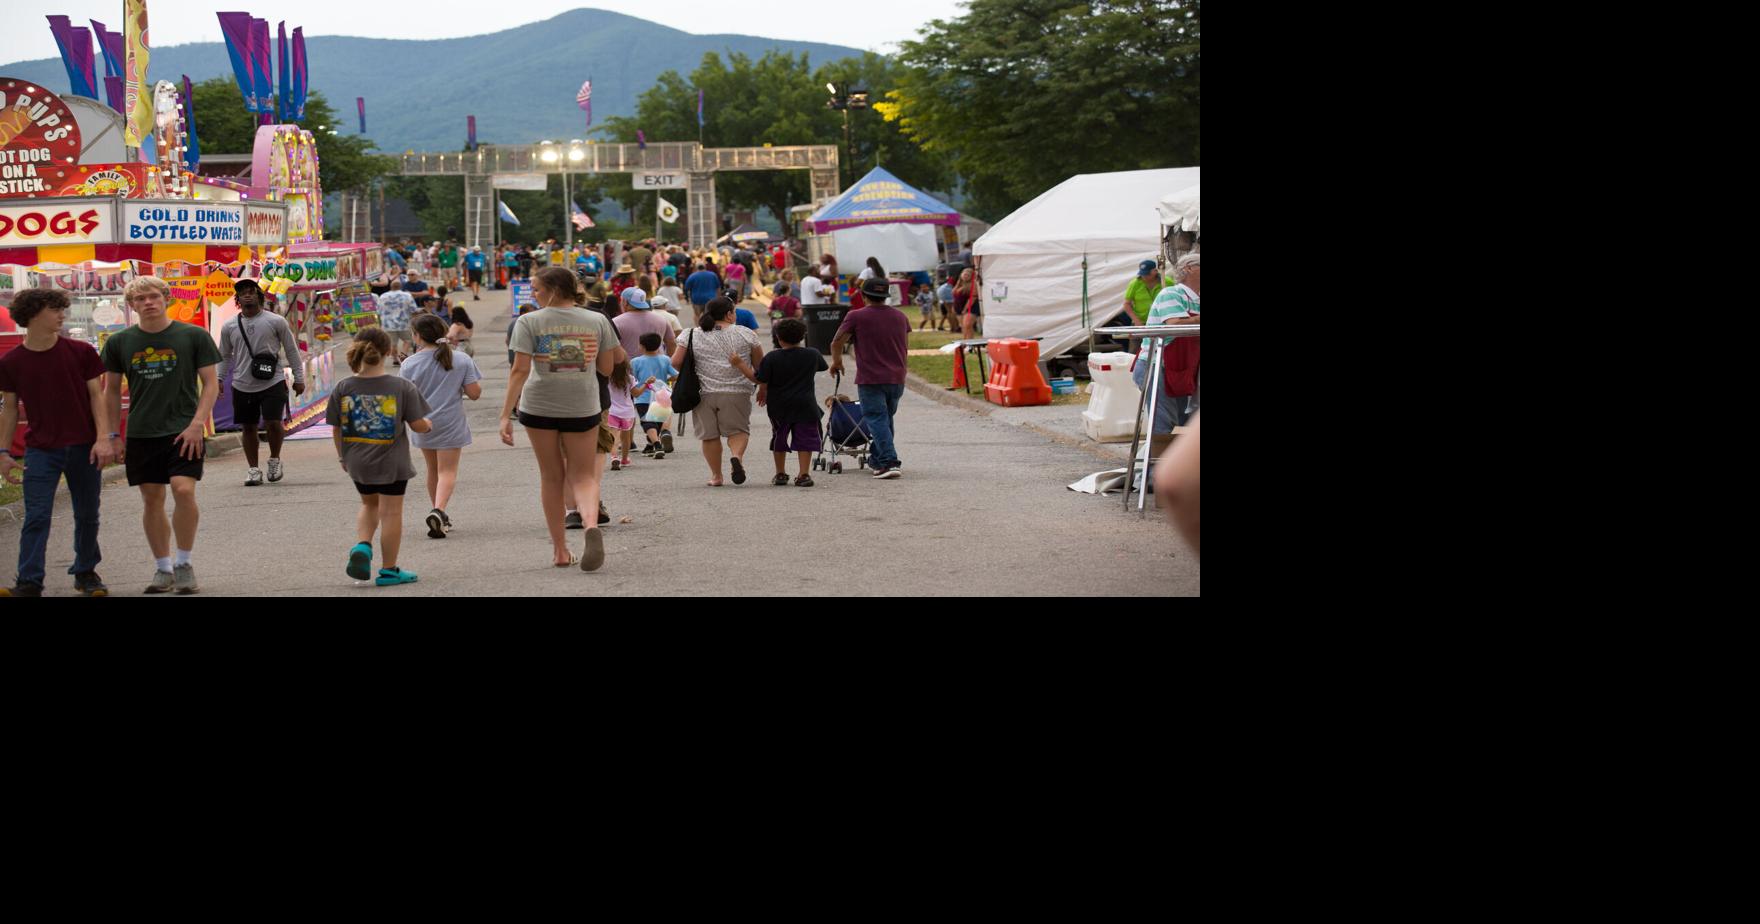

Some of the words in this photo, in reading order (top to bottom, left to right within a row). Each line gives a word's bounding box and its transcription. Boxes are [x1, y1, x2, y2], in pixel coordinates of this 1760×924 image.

[13, 94, 68, 142] PUPS
[0, 150, 16, 163] OT
[19, 148, 51, 162] DOG
[2, 165, 24, 179] ON
[26, 164, 37, 177] A
[88, 172, 121, 185] FAMILY
[0, 178, 45, 194] STICK
[644, 175, 673, 185] EXIT
[139, 208, 189, 222] COLD
[195, 209, 241, 223] DRINKS
[130, 224, 208, 240] BOTTLED
[210, 226, 242, 240] WATER
[262, 263, 304, 283] COLD
[170, 287, 200, 301] MONADE
